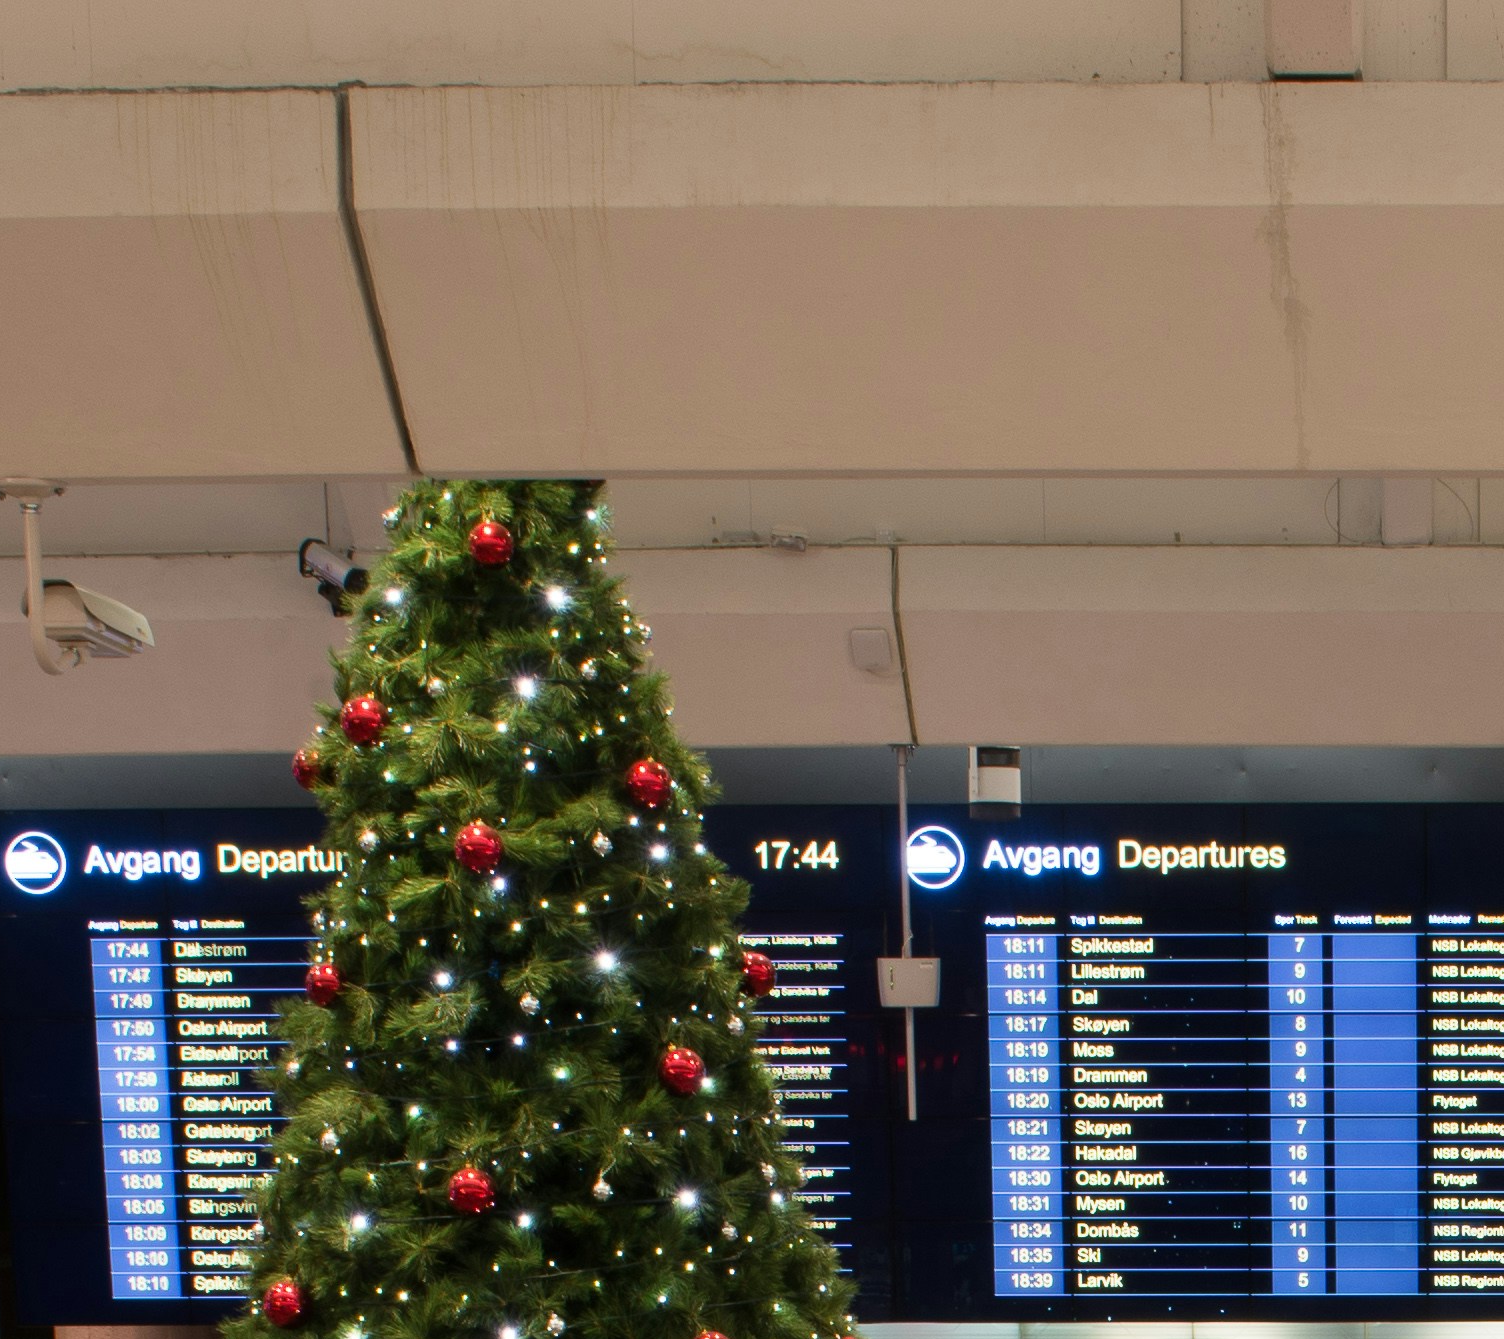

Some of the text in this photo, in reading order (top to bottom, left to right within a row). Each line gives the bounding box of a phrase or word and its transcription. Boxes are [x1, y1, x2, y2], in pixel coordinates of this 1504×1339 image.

[84, 844, 201, 881] Avgang
[754, 840, 840, 869] 17:44
[983, 840, 1286, 876] Avgang Departures
[1003, 937, 1044, 954] 18:11
[1070, 937, 1154, 957] Spikkestad
[1294, 936, 1305, 953] 7
[1432, 939, 1459, 952] NSB
[1003, 963, 1045, 979] 18:11
[1071, 963, 1145, 979] Lillestrøm
[1294, 962, 1306, 979] 9
[1004, 988, 1047, 1005] 18:14
[1072, 989, 1098, 1005] Dal
[1286, 988, 1306, 1005] 10
[1005, 1015, 1048, 1032] 18:17
[1072, 1016, 1130, 1036] Skøyen
[1005, 1041, 1049, 1058] 18:19
[1073, 1041, 1115, 1058] Moss
[1006, 1067, 1049, 1083] 18:19
[1073, 1067, 1148, 1083] Drammen
[1007, 1092, 1050, 1109] 18:20
[1073, 1092, 1164, 1111] Oslo Airport
[1432, 1094, 1478, 1110] Flytoget
[1007, 1119, 1048, 1136] 18:21
[1074, 1119, 1132, 1139] Skøyen
[1008, 1145, 1051, 1161] 18:22
[1075, 1145, 1137, 1161] Hakadal
[1433, 1147, 1460, 1160] NSB
[1008, 1170, 1051, 1186] 18:30
[1075, 1170, 1165, 1189] Oslo Airport
[1009, 1195, 1049, 1211] 18:31
[1076, 1195, 1125, 1215] Mysen
[1010, 1222, 1052, 1238] 18:34
[1076, 1221, 1140, 1238] Dombås
[1010, 1247, 1053, 1263] 18:35
[1077, 1247, 1101, 1263] Ski
[1011, 1272, 1053, 1288] 18:39
[1077, 1272, 1124, 1288] Larvik
